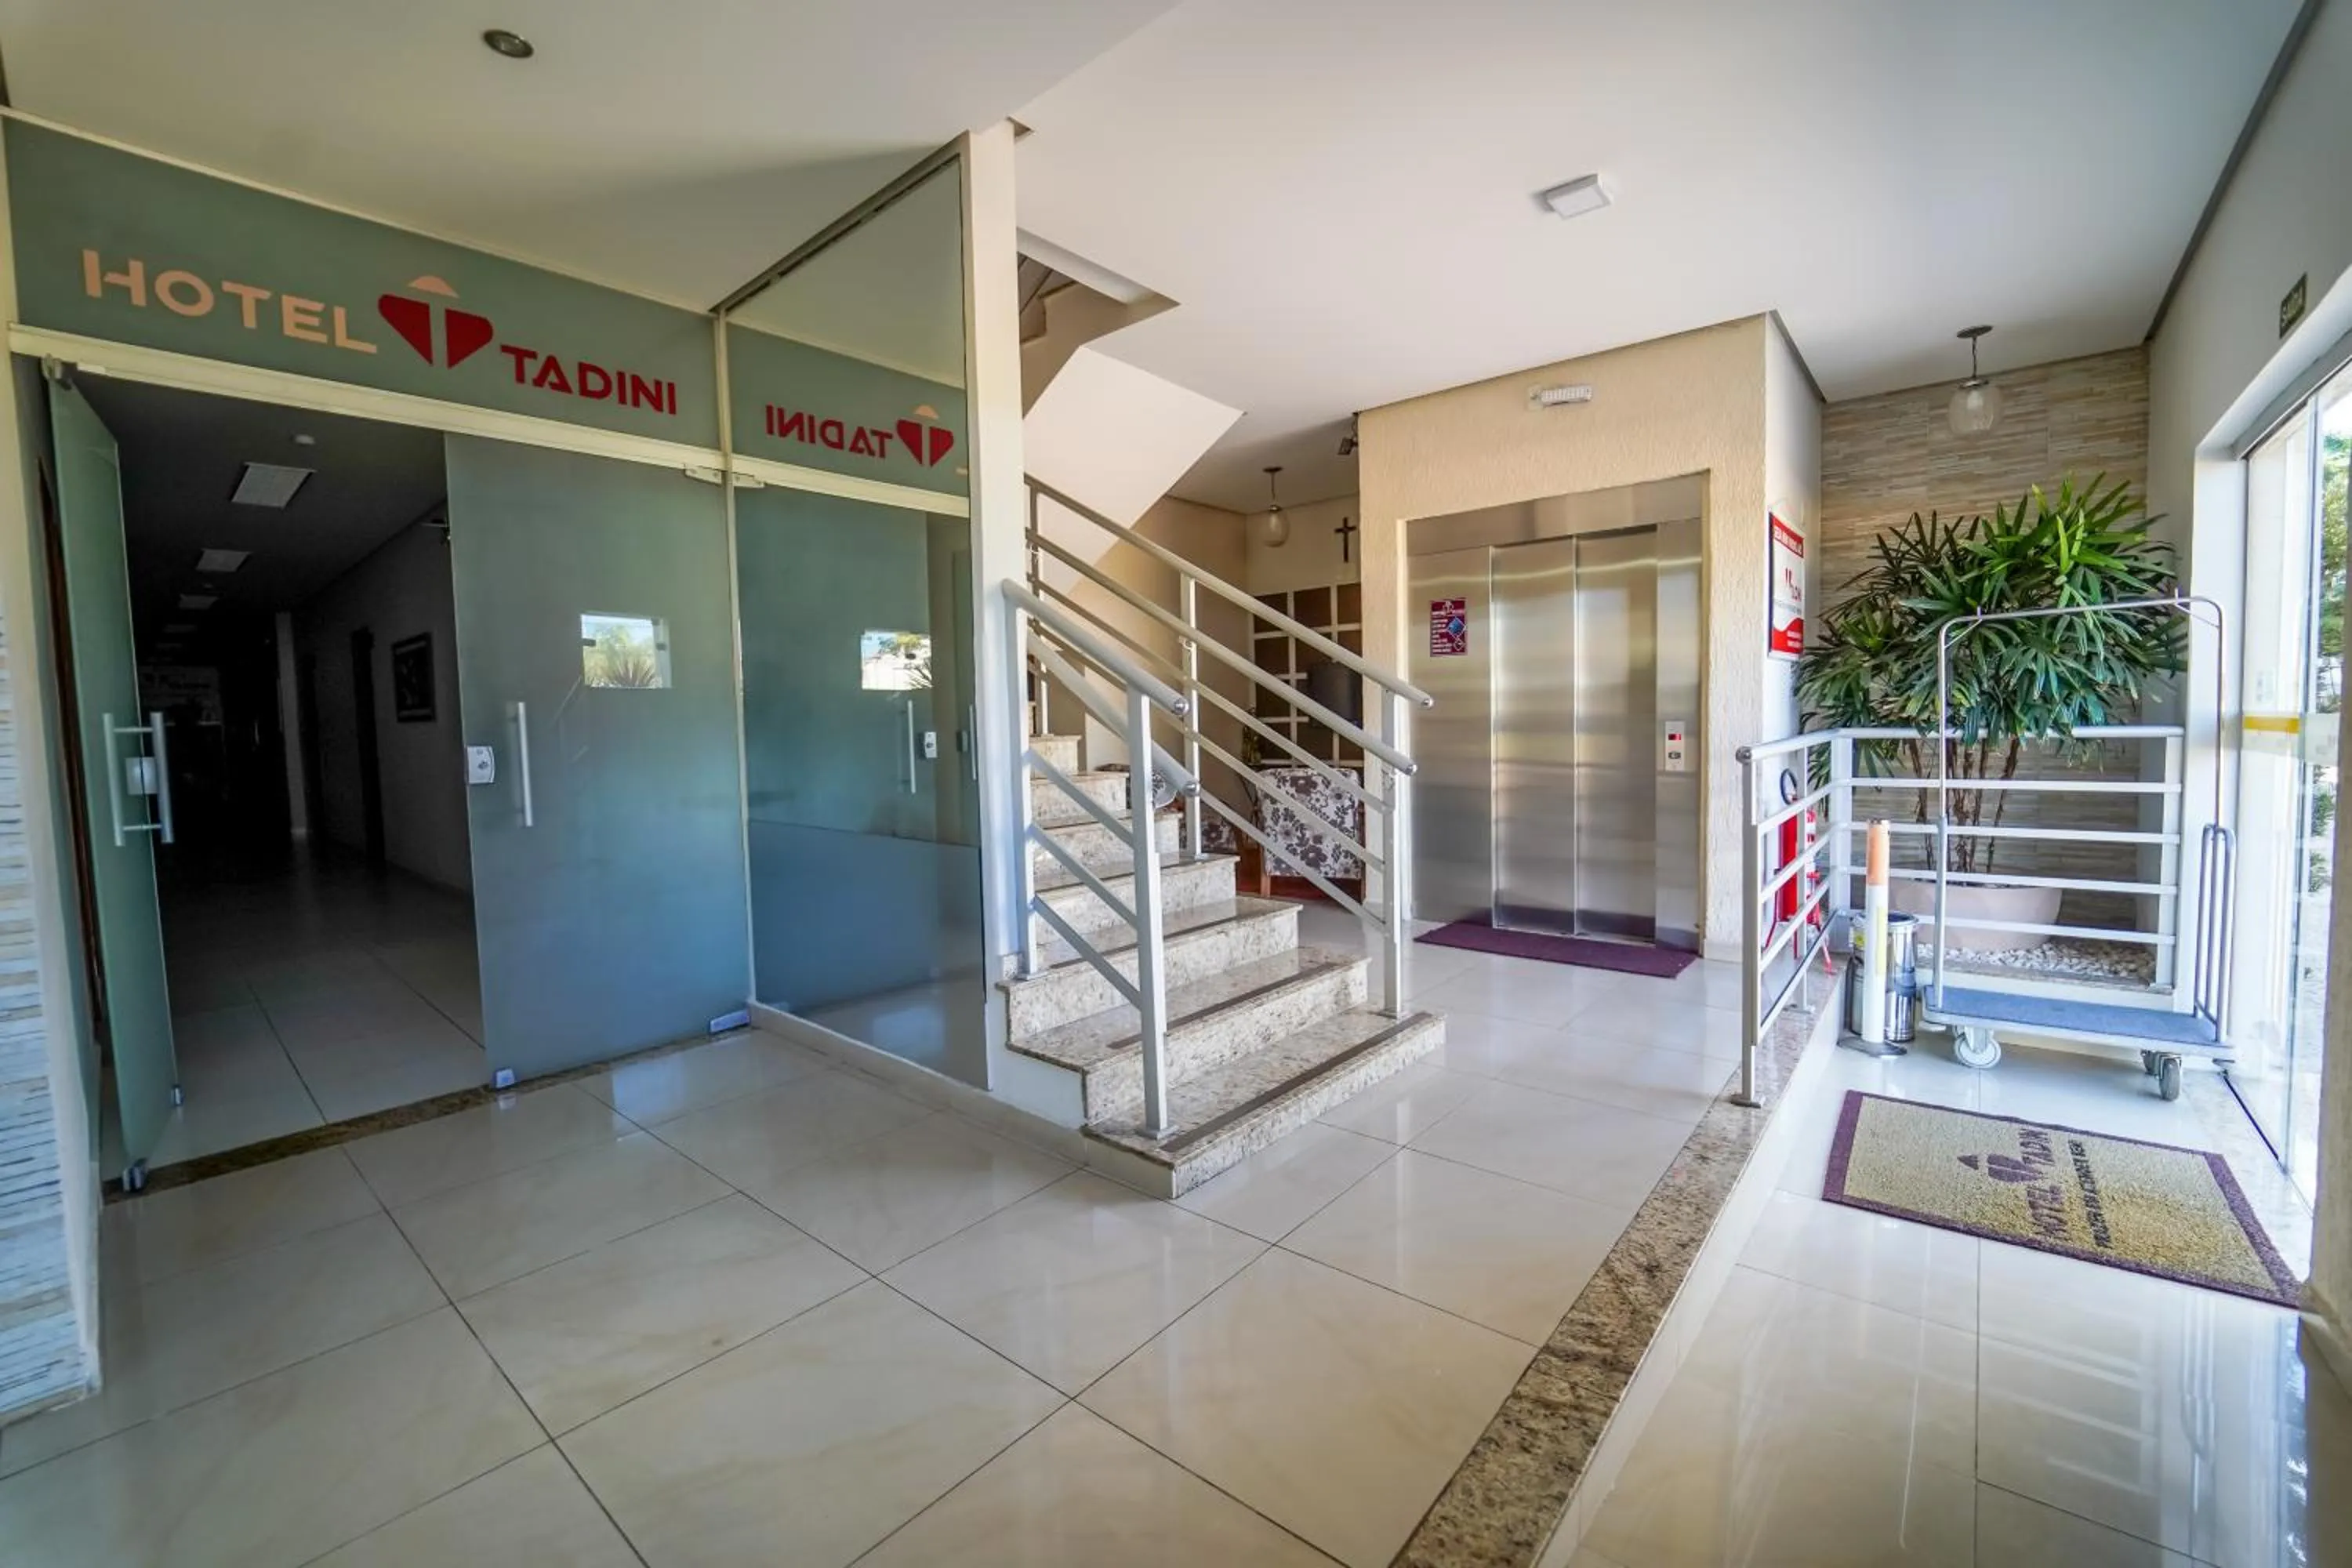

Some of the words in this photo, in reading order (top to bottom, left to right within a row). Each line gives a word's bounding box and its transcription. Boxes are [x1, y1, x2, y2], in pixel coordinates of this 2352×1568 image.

[82, 248, 378, 355] HOTEL
[499, 343, 678, 416] TADINI
[2026, 1184, 2071, 1243] HOTEL
